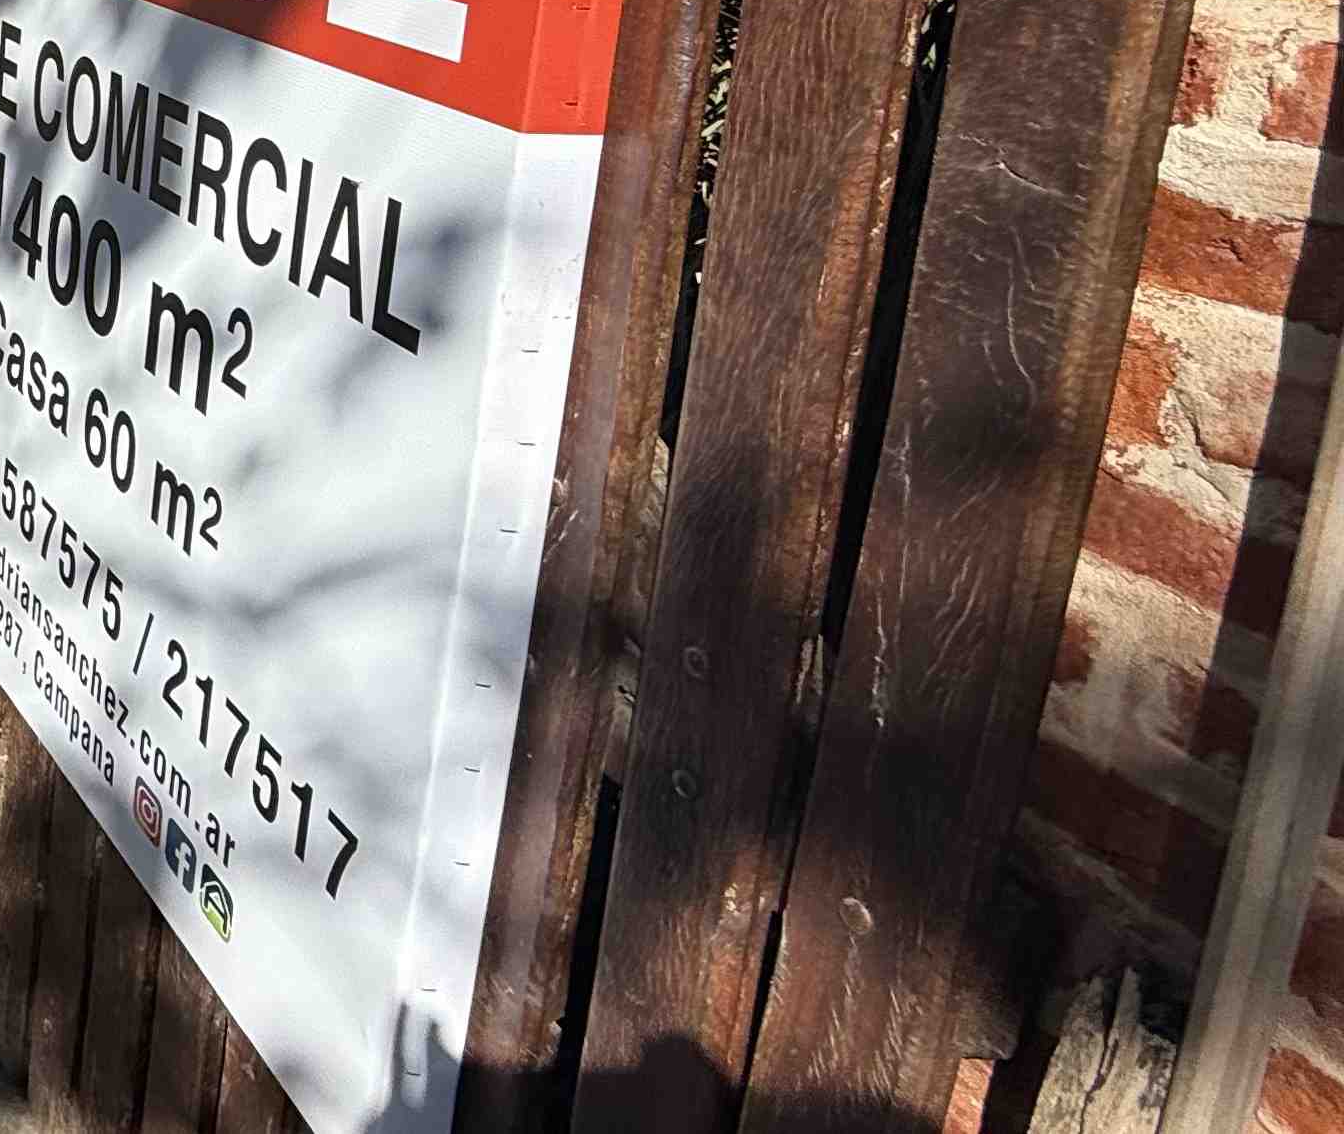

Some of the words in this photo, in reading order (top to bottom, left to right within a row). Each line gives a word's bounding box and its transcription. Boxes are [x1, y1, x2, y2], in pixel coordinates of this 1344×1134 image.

[33, 40, 421, 356] COMERCIAL
[84, 388, 137, 493] 60
[1, 458, 124, 641] 587575
[132, 612, 154, 676] /
[161, 638, 359, 901] 217517
[33, 649, 115, 787] Campana
